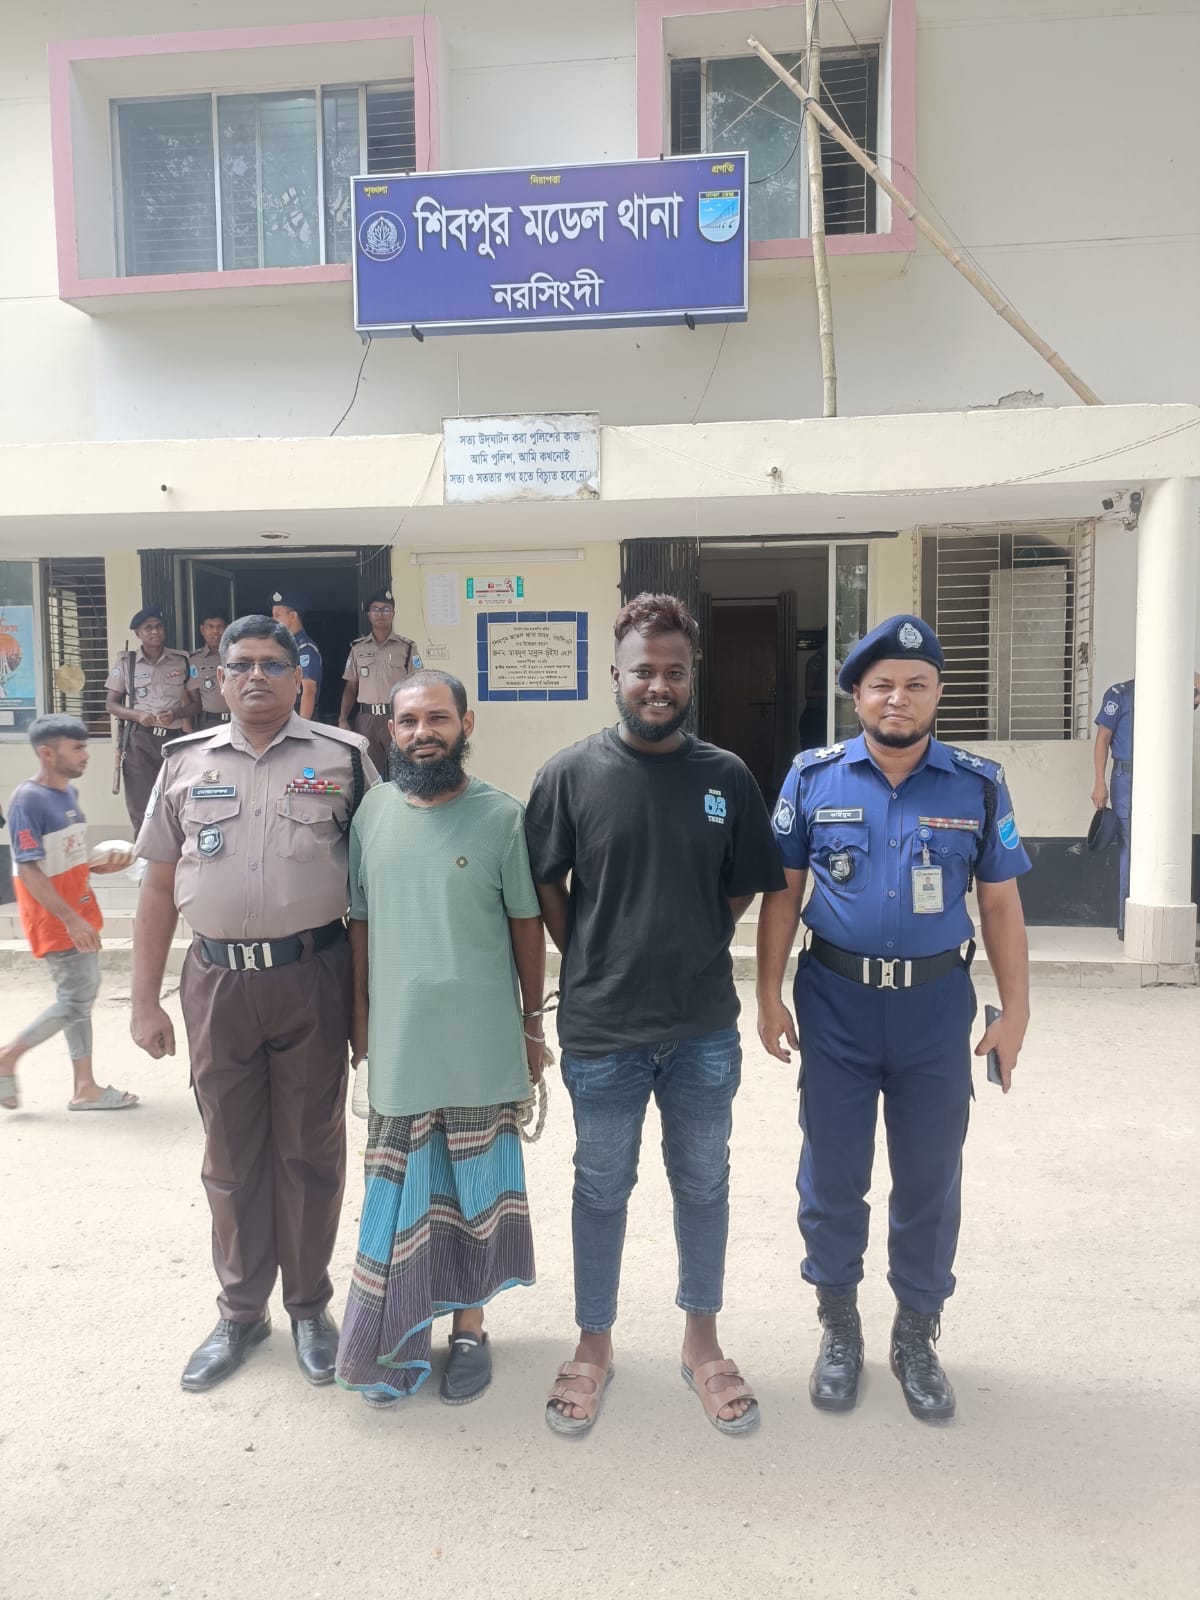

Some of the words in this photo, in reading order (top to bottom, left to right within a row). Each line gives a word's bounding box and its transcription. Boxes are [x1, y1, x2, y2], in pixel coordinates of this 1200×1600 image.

[412, 195, 514, 259] শিবপুর
[519, 200, 608, 245] মডেল
[617, 191, 684, 240] থানা
[490, 267, 605, 312] নরসিংদী
[459, 434, 476, 446] সত্য
[511, 432, 527, 444] করা
[529, 429, 561, 446] পুলিশের
[563, 431, 582, 443] কাজ
[470, 451, 488, 464] আমি
[491, 449, 516, 466] পুলিশ,
[518, 448, 537, 463] আমি
[539, 448, 571, 463] কখনোই
[449, 473, 465, 485] সত্য
[467, 474, 474, 483] ও
[476, 472, 502, 484] সততার
[504, 471, 516, 482] পথ
[518, 471, 534, 482] হতে
[560, 470, 577, 481] হবো
